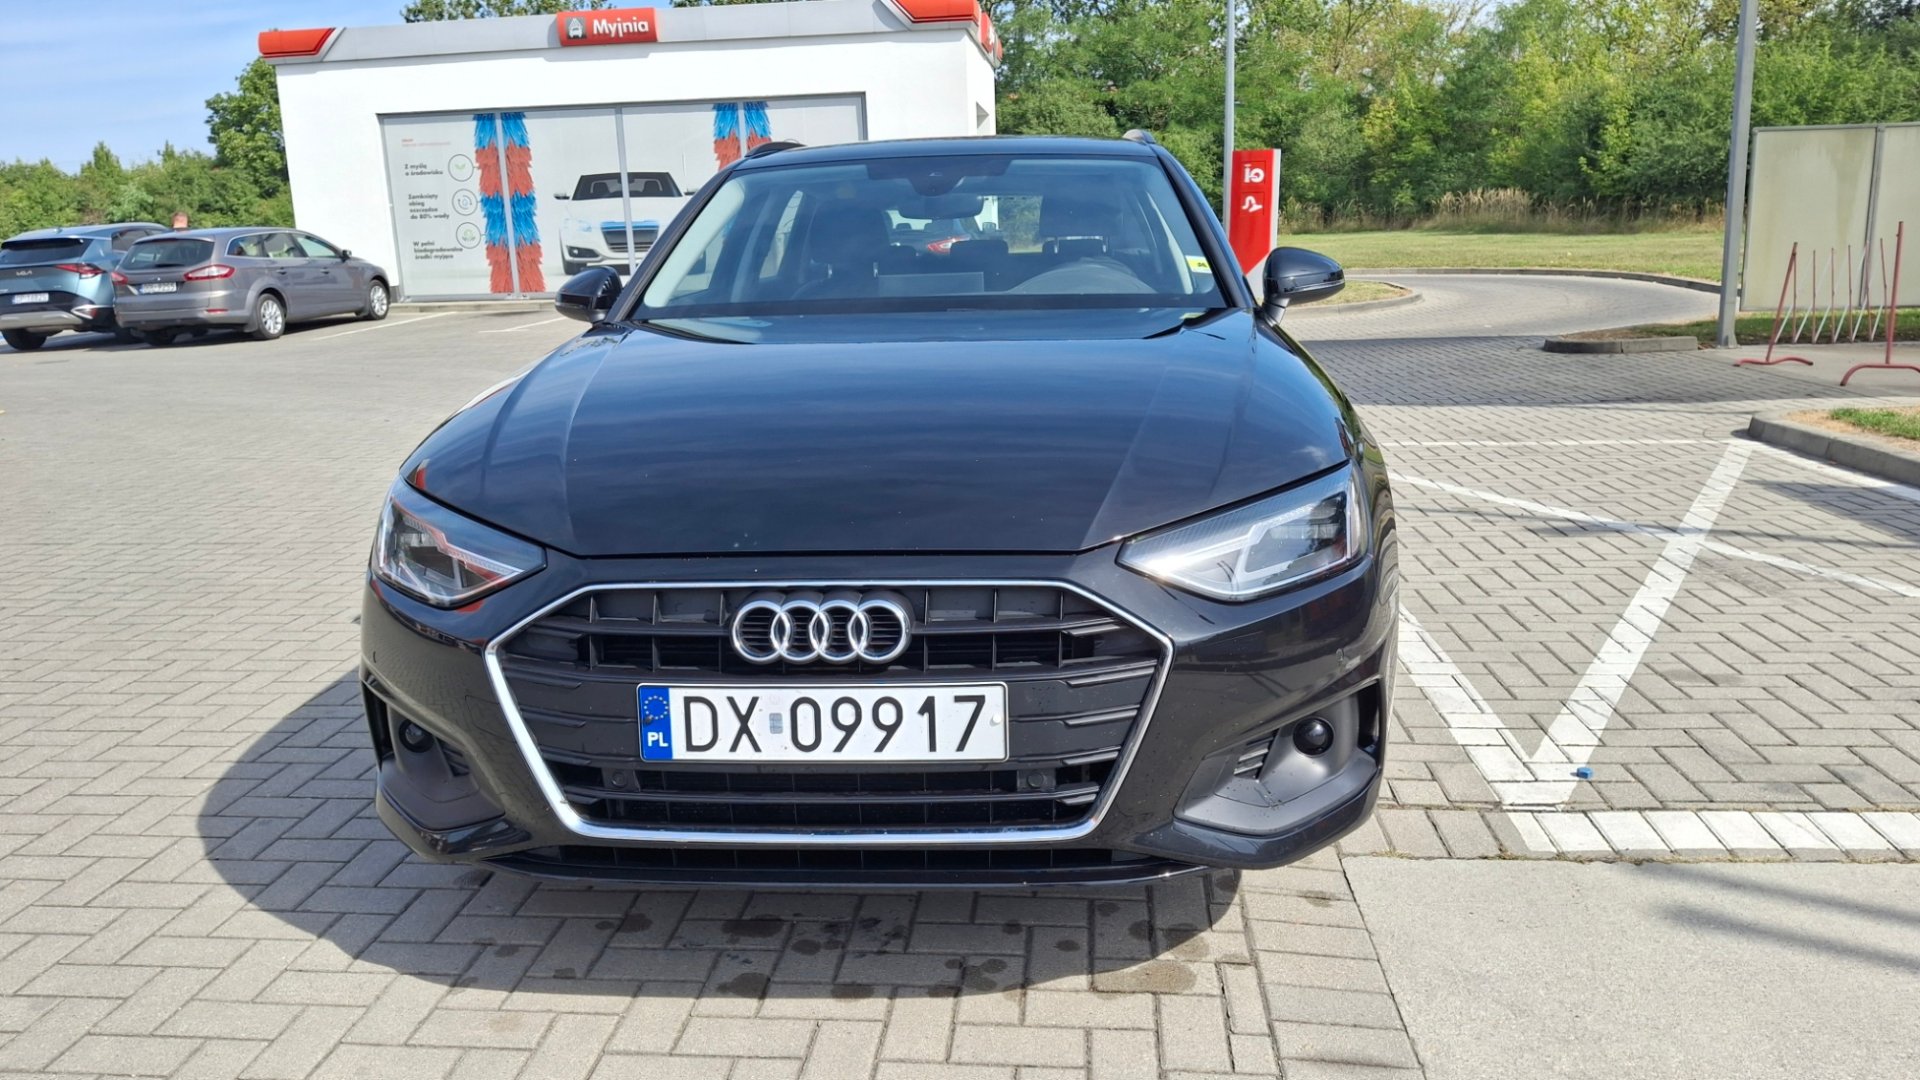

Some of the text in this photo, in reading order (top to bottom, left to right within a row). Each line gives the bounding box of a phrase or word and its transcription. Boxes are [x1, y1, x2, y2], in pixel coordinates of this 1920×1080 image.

[593, 16, 649, 37] Myjnia
[647, 695, 986, 753] PL DX 09917
